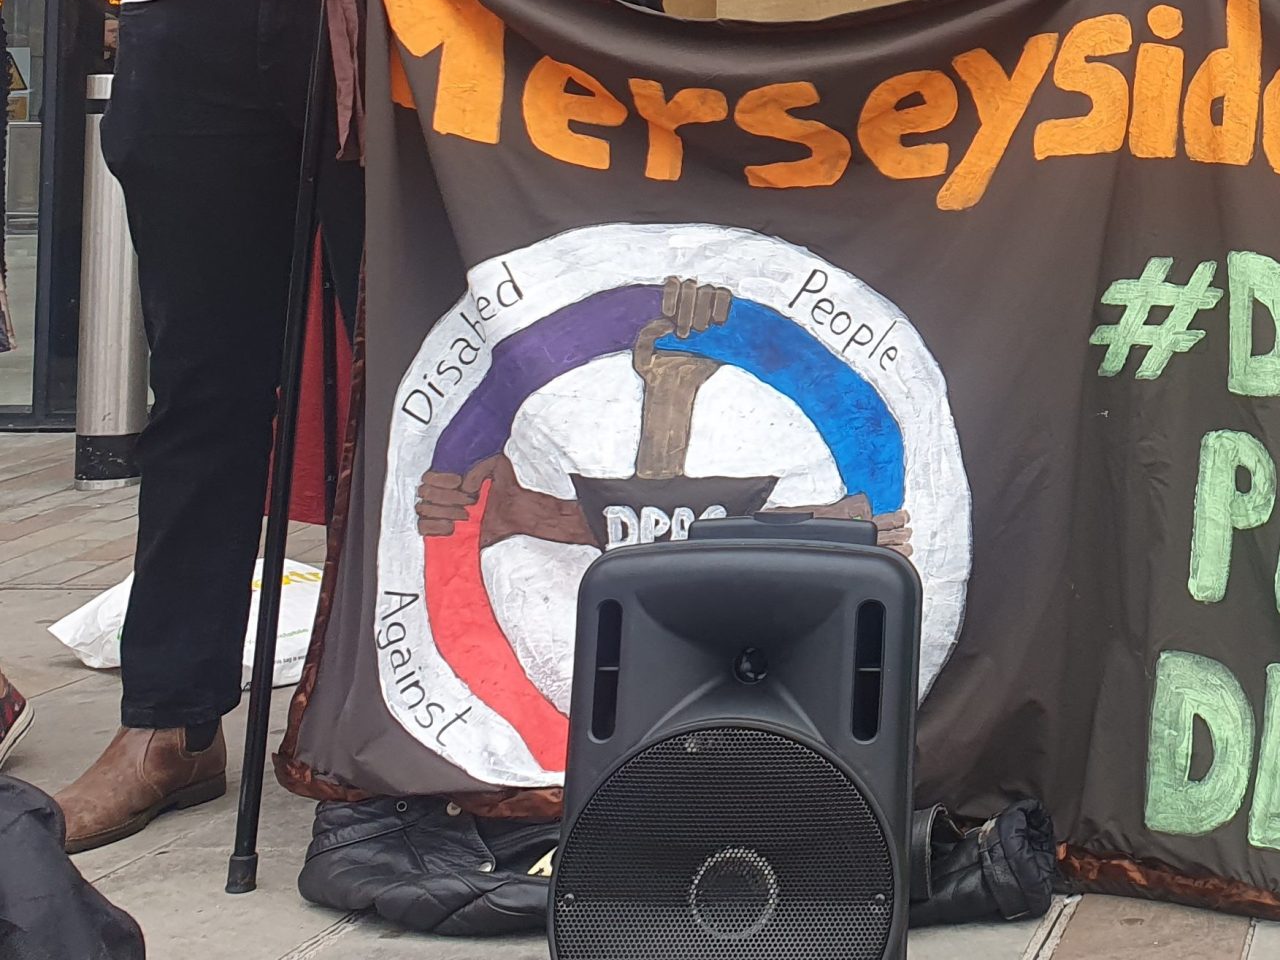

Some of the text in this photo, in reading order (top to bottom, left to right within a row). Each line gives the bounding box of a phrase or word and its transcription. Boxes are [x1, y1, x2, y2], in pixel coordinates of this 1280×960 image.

[402, 261, 904, 426] Disabed People
[376, 590, 472, 746] Against
